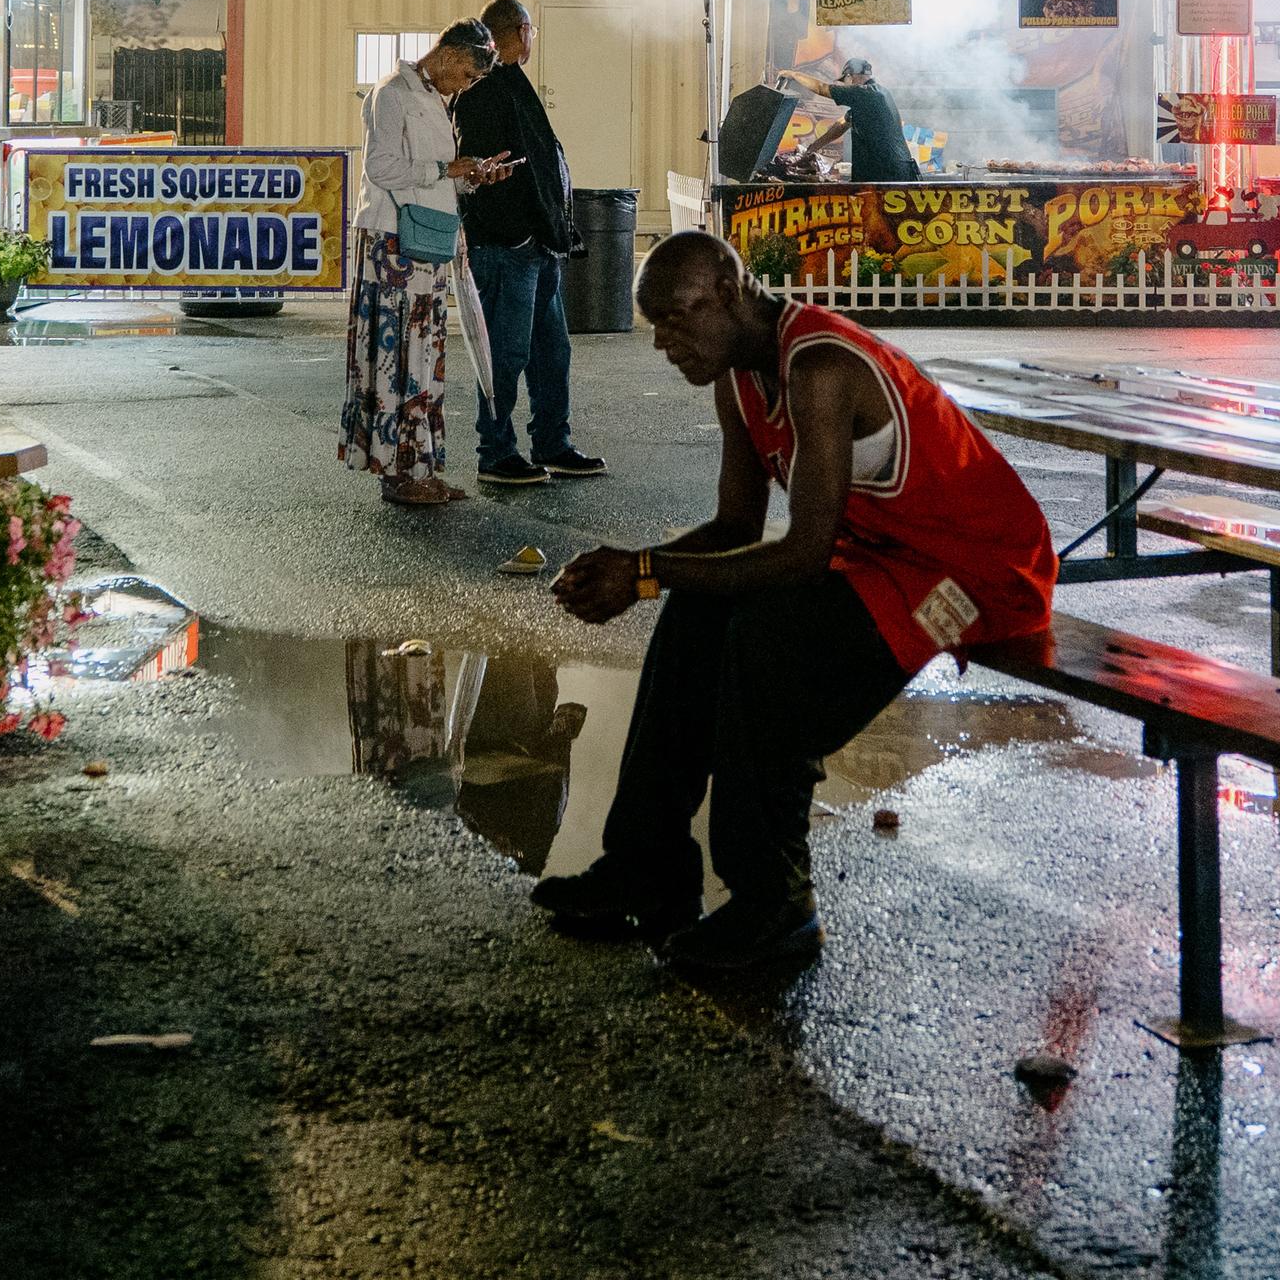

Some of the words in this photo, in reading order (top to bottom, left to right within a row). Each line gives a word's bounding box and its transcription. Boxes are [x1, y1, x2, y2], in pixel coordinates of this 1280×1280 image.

[1207, 101, 1244, 122] PULLED
[1246, 102, 1270, 121] PORK
[1219, 126, 1259, 140] SUNDAE
[67, 166, 156, 202] FRESH
[161, 166, 304, 203] SQUEEZED
[734, 185, 786, 211] JUMBO
[883, 188, 1030, 214] SWEET
[730, 194, 865, 254] TURKEY
[897, 219, 1017, 246] CORN
[1043, 185, 1186, 263] PORK
[51, 215, 321, 272] LEMONADE
[798, 226, 865, 256] LEGS
[1235, 263, 1275, 276] RIENDS
